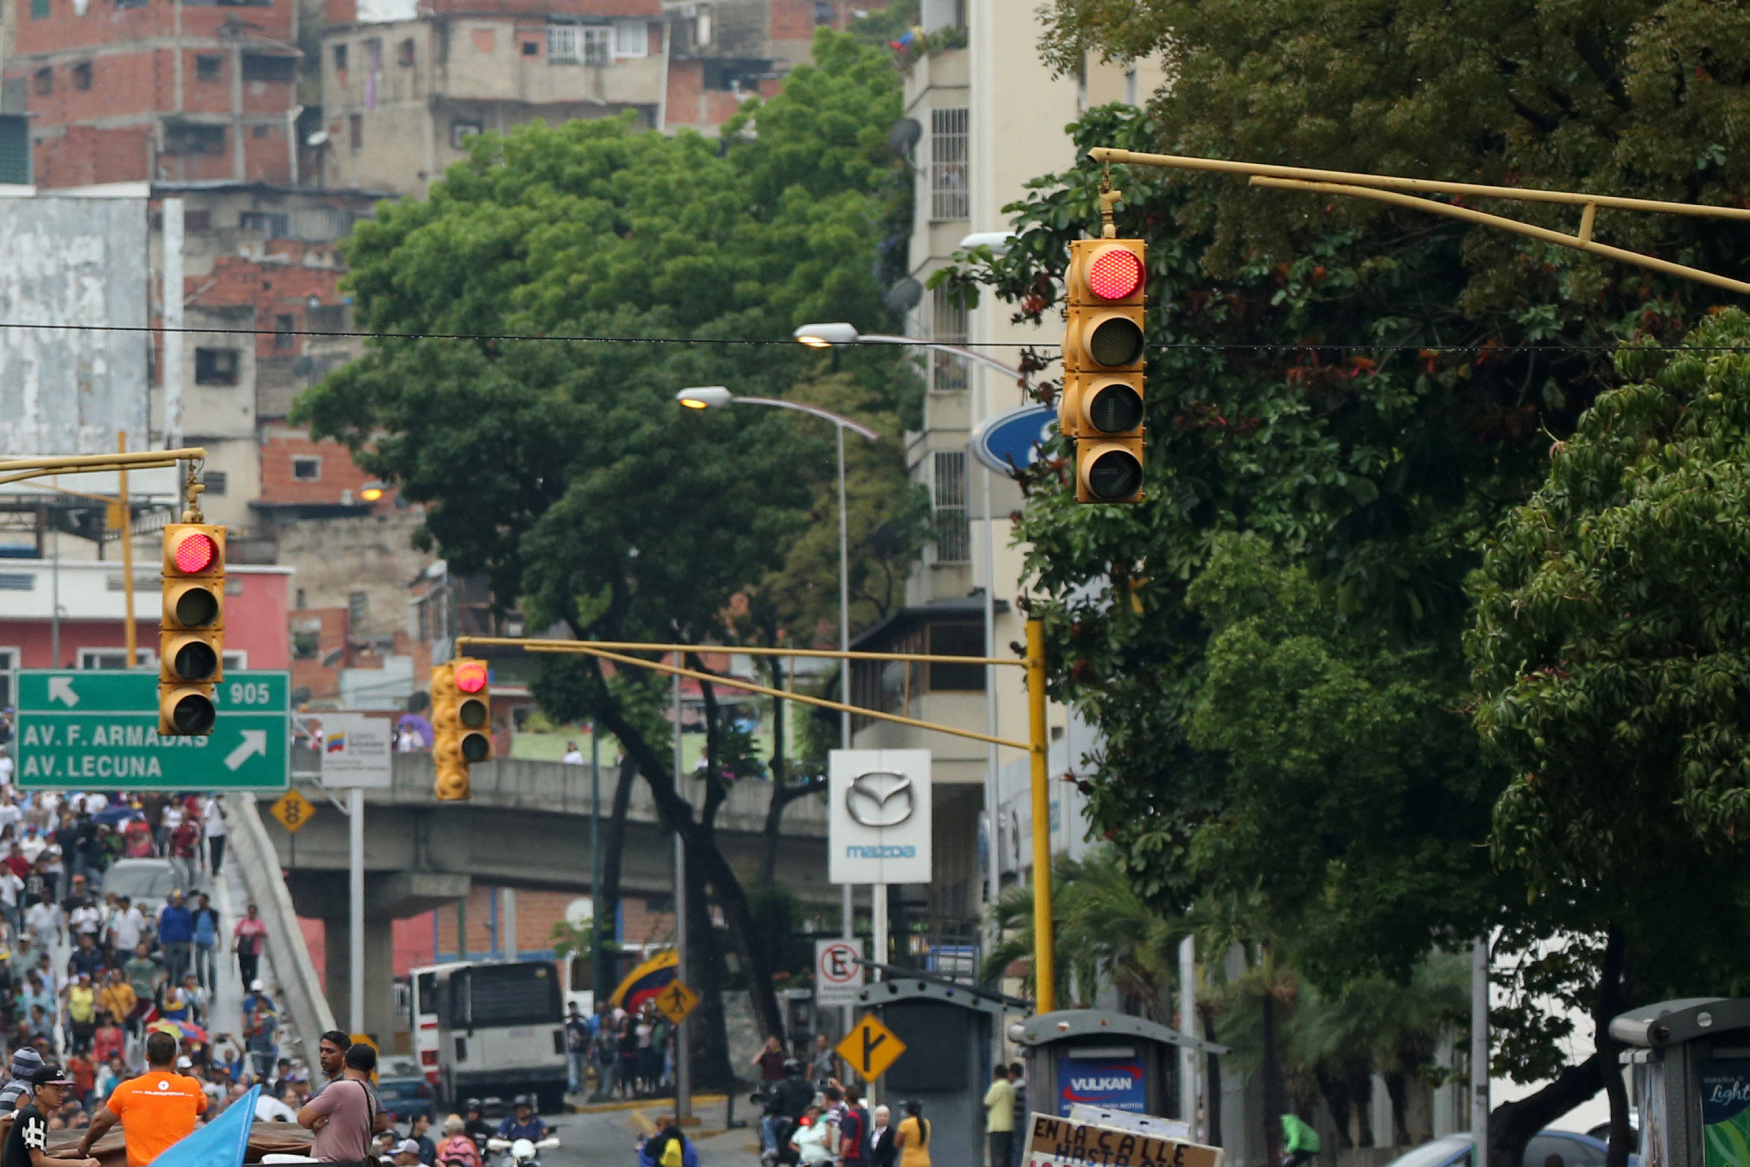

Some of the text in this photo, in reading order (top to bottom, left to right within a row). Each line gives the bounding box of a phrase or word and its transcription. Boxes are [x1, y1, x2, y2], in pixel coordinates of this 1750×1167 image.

[231, 683, 270, 704] 905
[23, 725, 61, 747] AV.
[67, 725, 87, 746] F.
[23, 756, 162, 777] AV. LECUNA
[1071, 1077, 1132, 1091] VULKAN
[1034, 1117, 1190, 1166] EN LA CALLE
